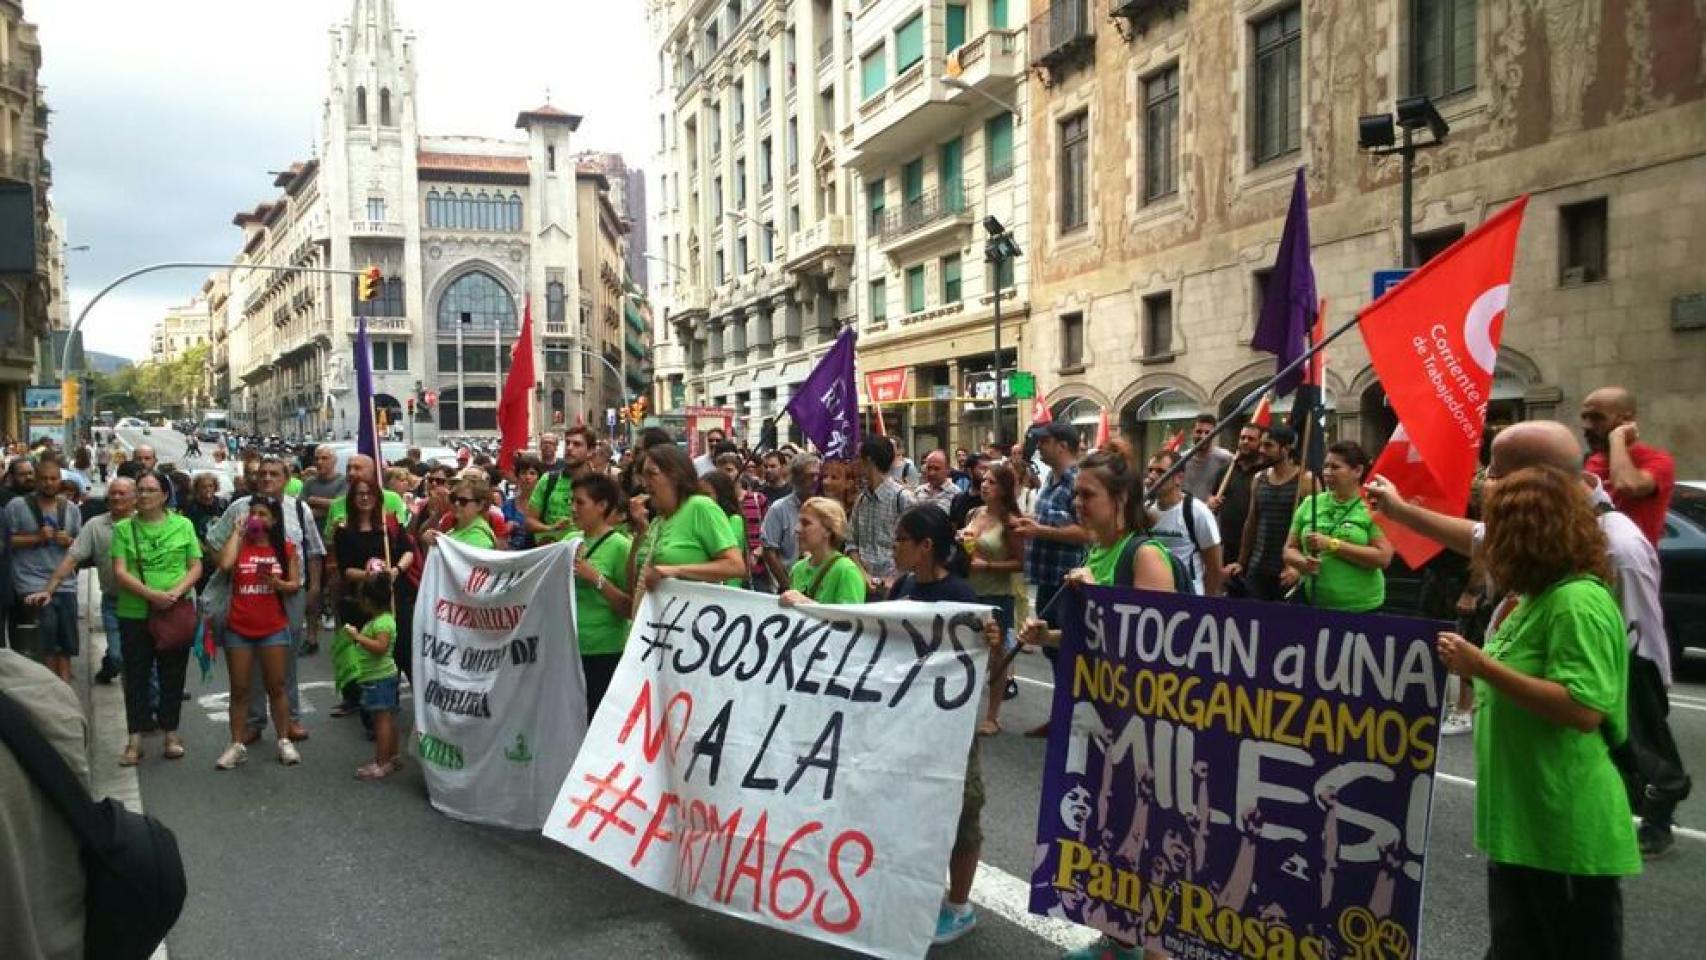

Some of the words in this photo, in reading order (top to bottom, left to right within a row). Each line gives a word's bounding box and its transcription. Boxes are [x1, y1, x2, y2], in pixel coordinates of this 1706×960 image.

[1412, 336, 1428, 356] de
[1424, 353, 1478, 439] Trabajadores
[1431, 324, 1480, 401] Corriente
[641, 597, 984, 711] #SOSKELLYS
[1113, 603, 1260, 679] TOCAN
[1273, 644, 1306, 689] a
[1315, 627, 1438, 708] UNA
[617, 679, 694, 766] NO
[685, 699, 733, 786] A
[742, 703, 845, 800] LA
[1073, 655, 1131, 710] NOS
[1134, 670, 1436, 771] ORGANIZAMOS
[1065, 701, 1434, 883] MILES!
[1053, 838, 1143, 915] Pan
[1146, 883, 1175, 936] y
[1176, 880, 1327, 960] Rosas
